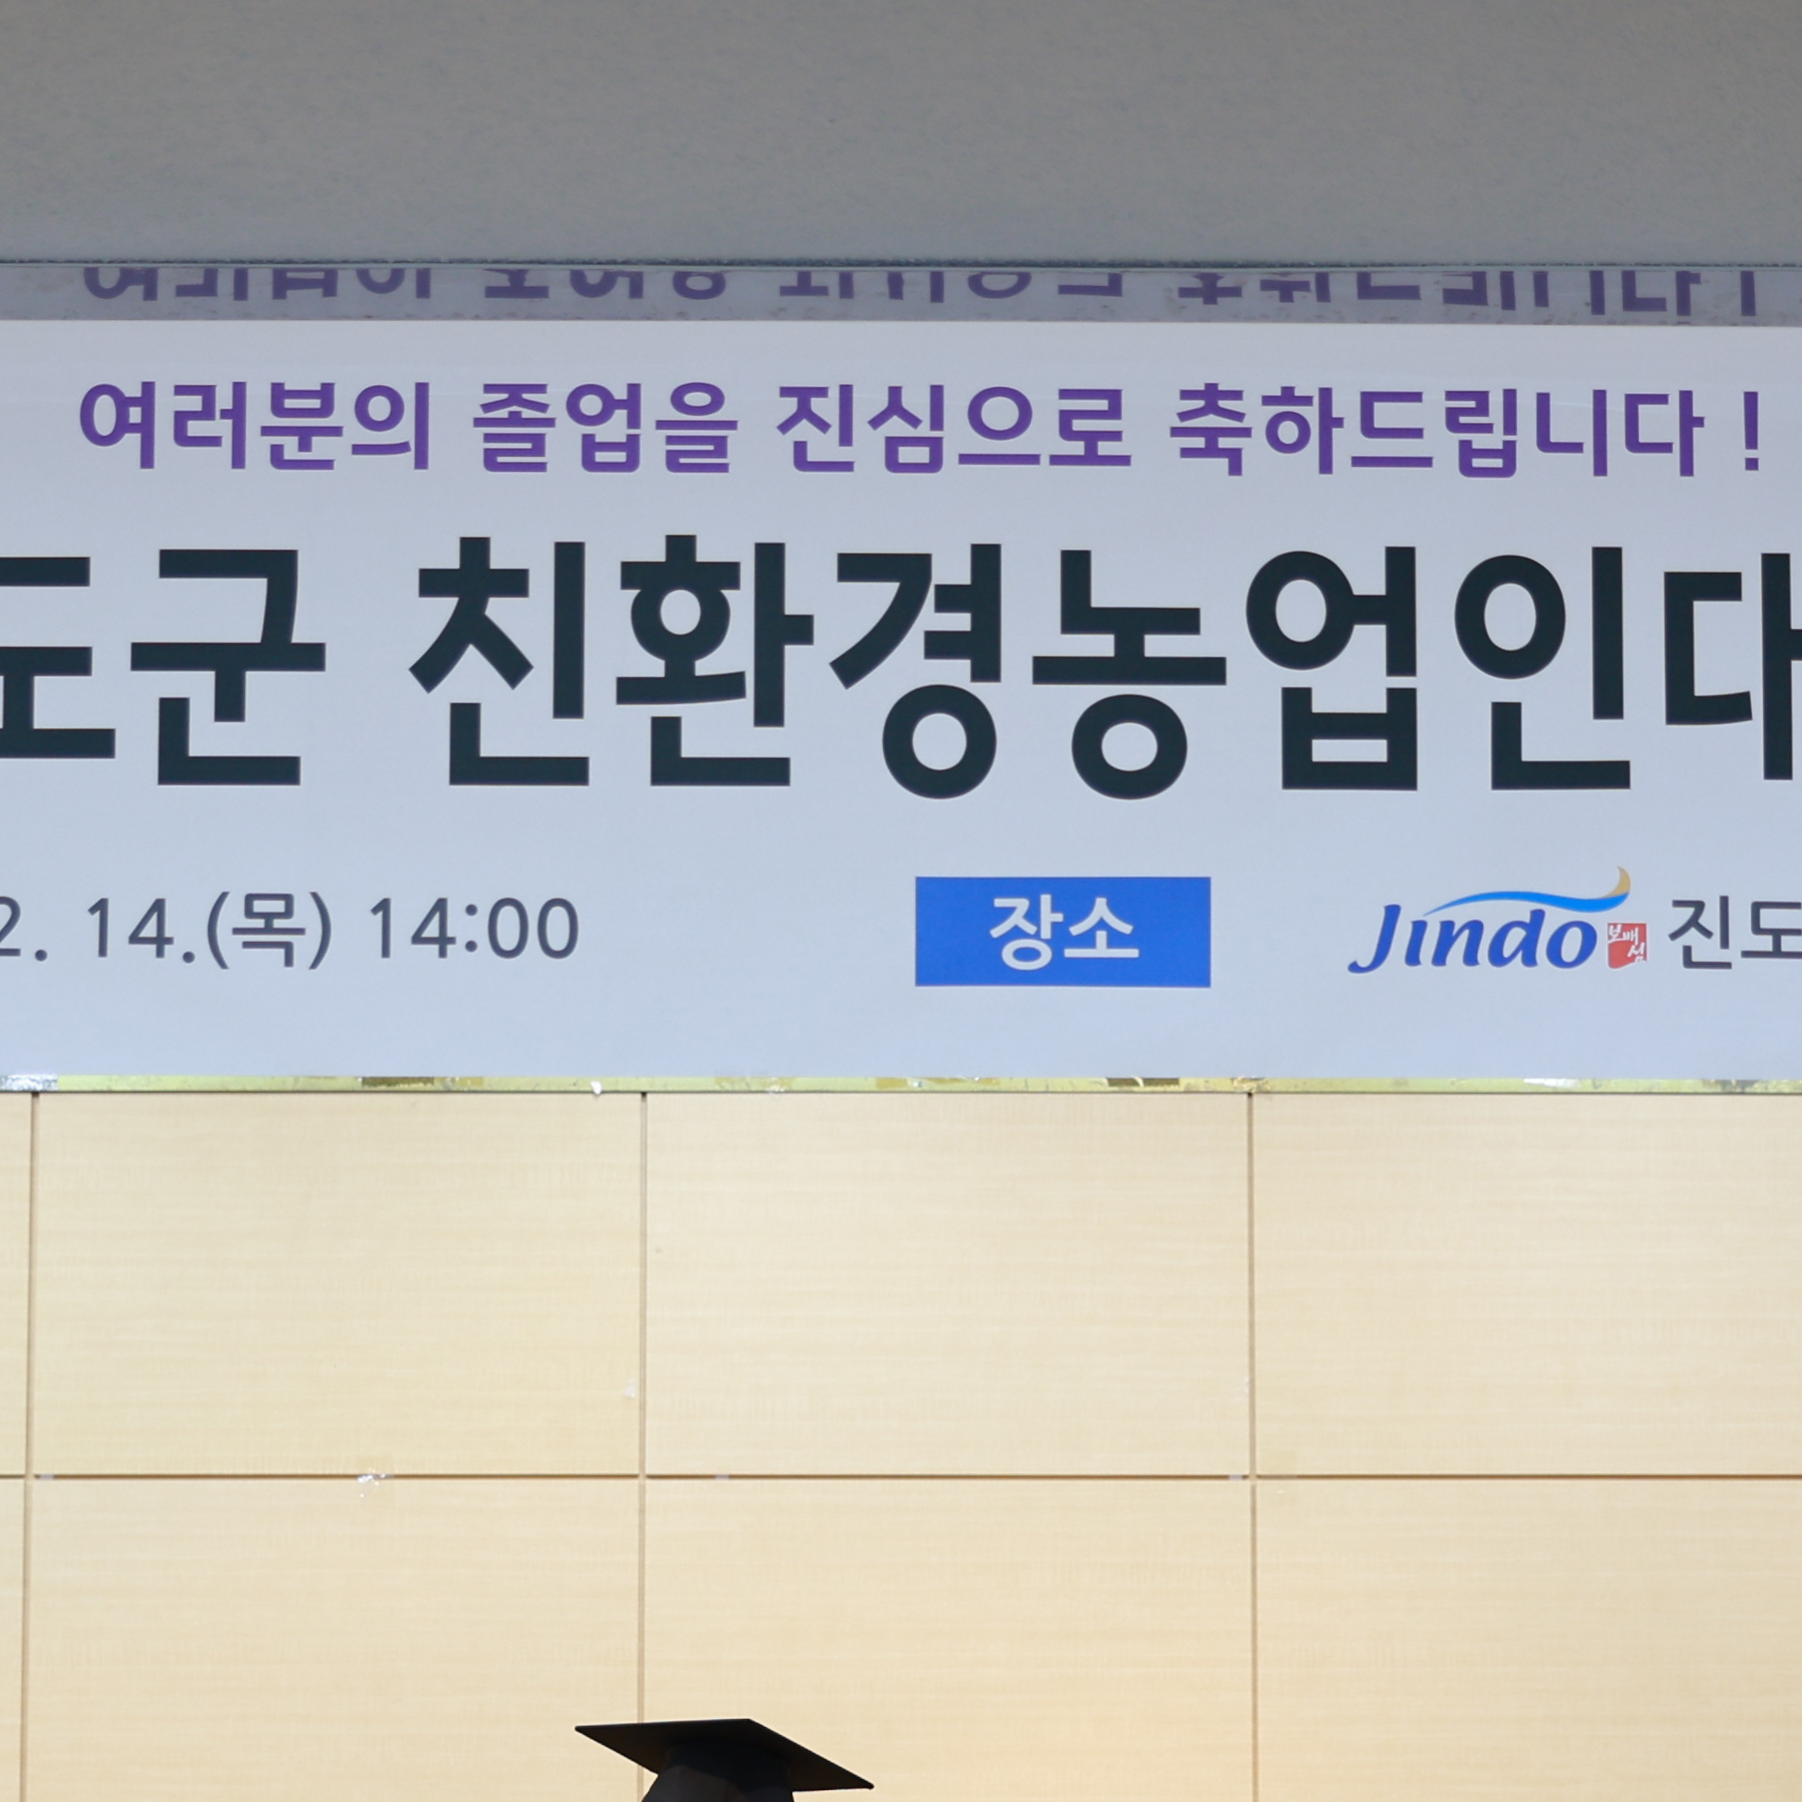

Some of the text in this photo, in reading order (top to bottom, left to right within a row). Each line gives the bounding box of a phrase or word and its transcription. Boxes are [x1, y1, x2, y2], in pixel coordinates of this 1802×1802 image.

[80, 382, 429, 470] 여러분의
[474, 382, 737, 473] 졸업을
[777, 384, 1131, 473] 진심으로
[1170, 383, 1704, 478] 축하드립니다
[88, 892, 331, 969] 14.(목)
[371, 898, 578, 959] 14:00
[989, 894, 1140, 970] 장소
[1348, 903, 1598, 974] Jindo
